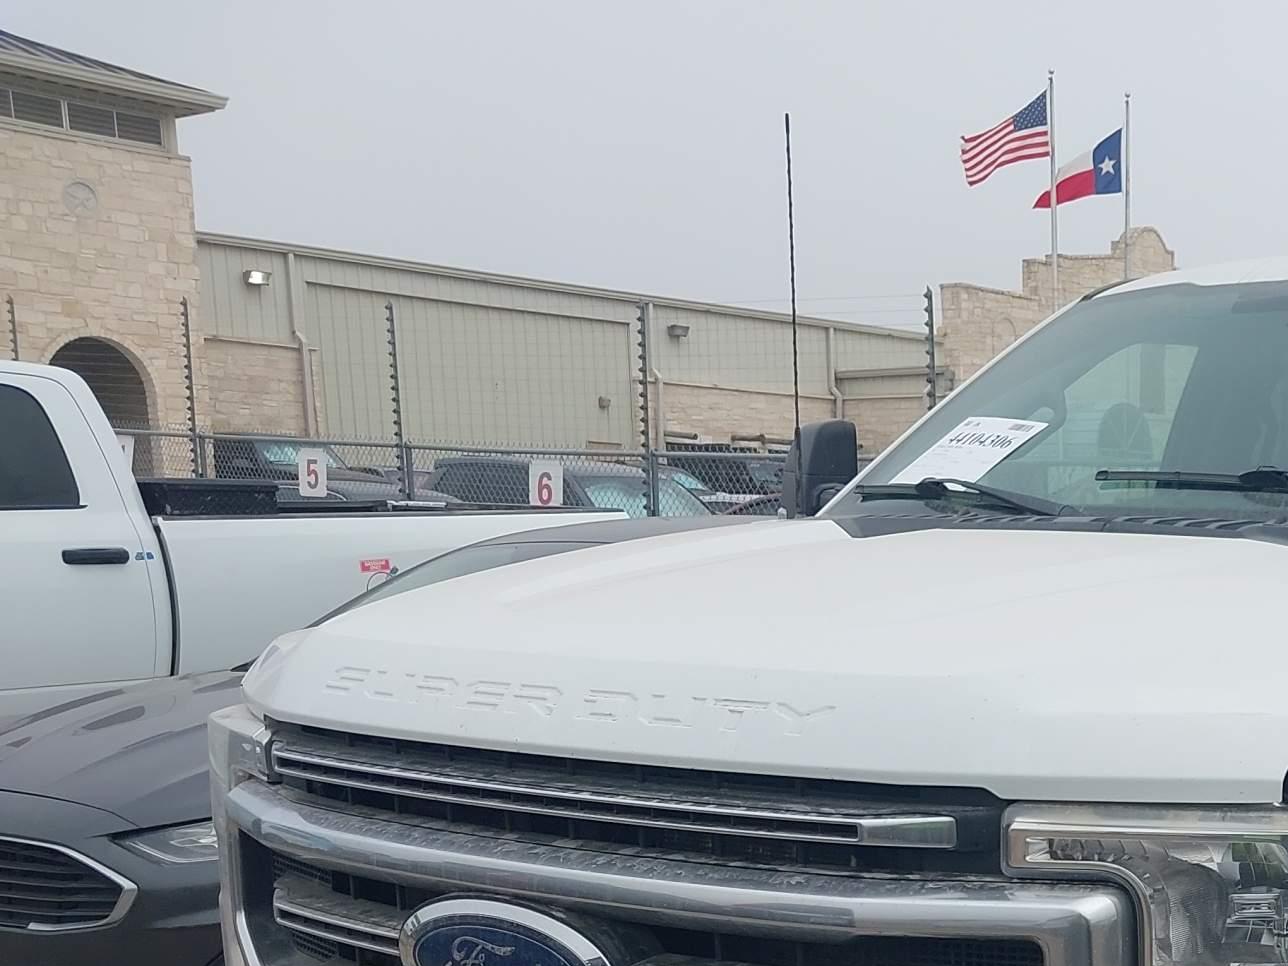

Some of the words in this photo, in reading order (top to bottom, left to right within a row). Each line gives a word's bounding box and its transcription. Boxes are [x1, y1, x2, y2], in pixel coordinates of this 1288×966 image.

[949, 432, 1016, 448] 44104306
[306, 459, 319, 489] 5
[537, 472, 552, 505] 6
[322, 666, 564, 718] SUPER
[575, 688, 837, 736] DUTY
